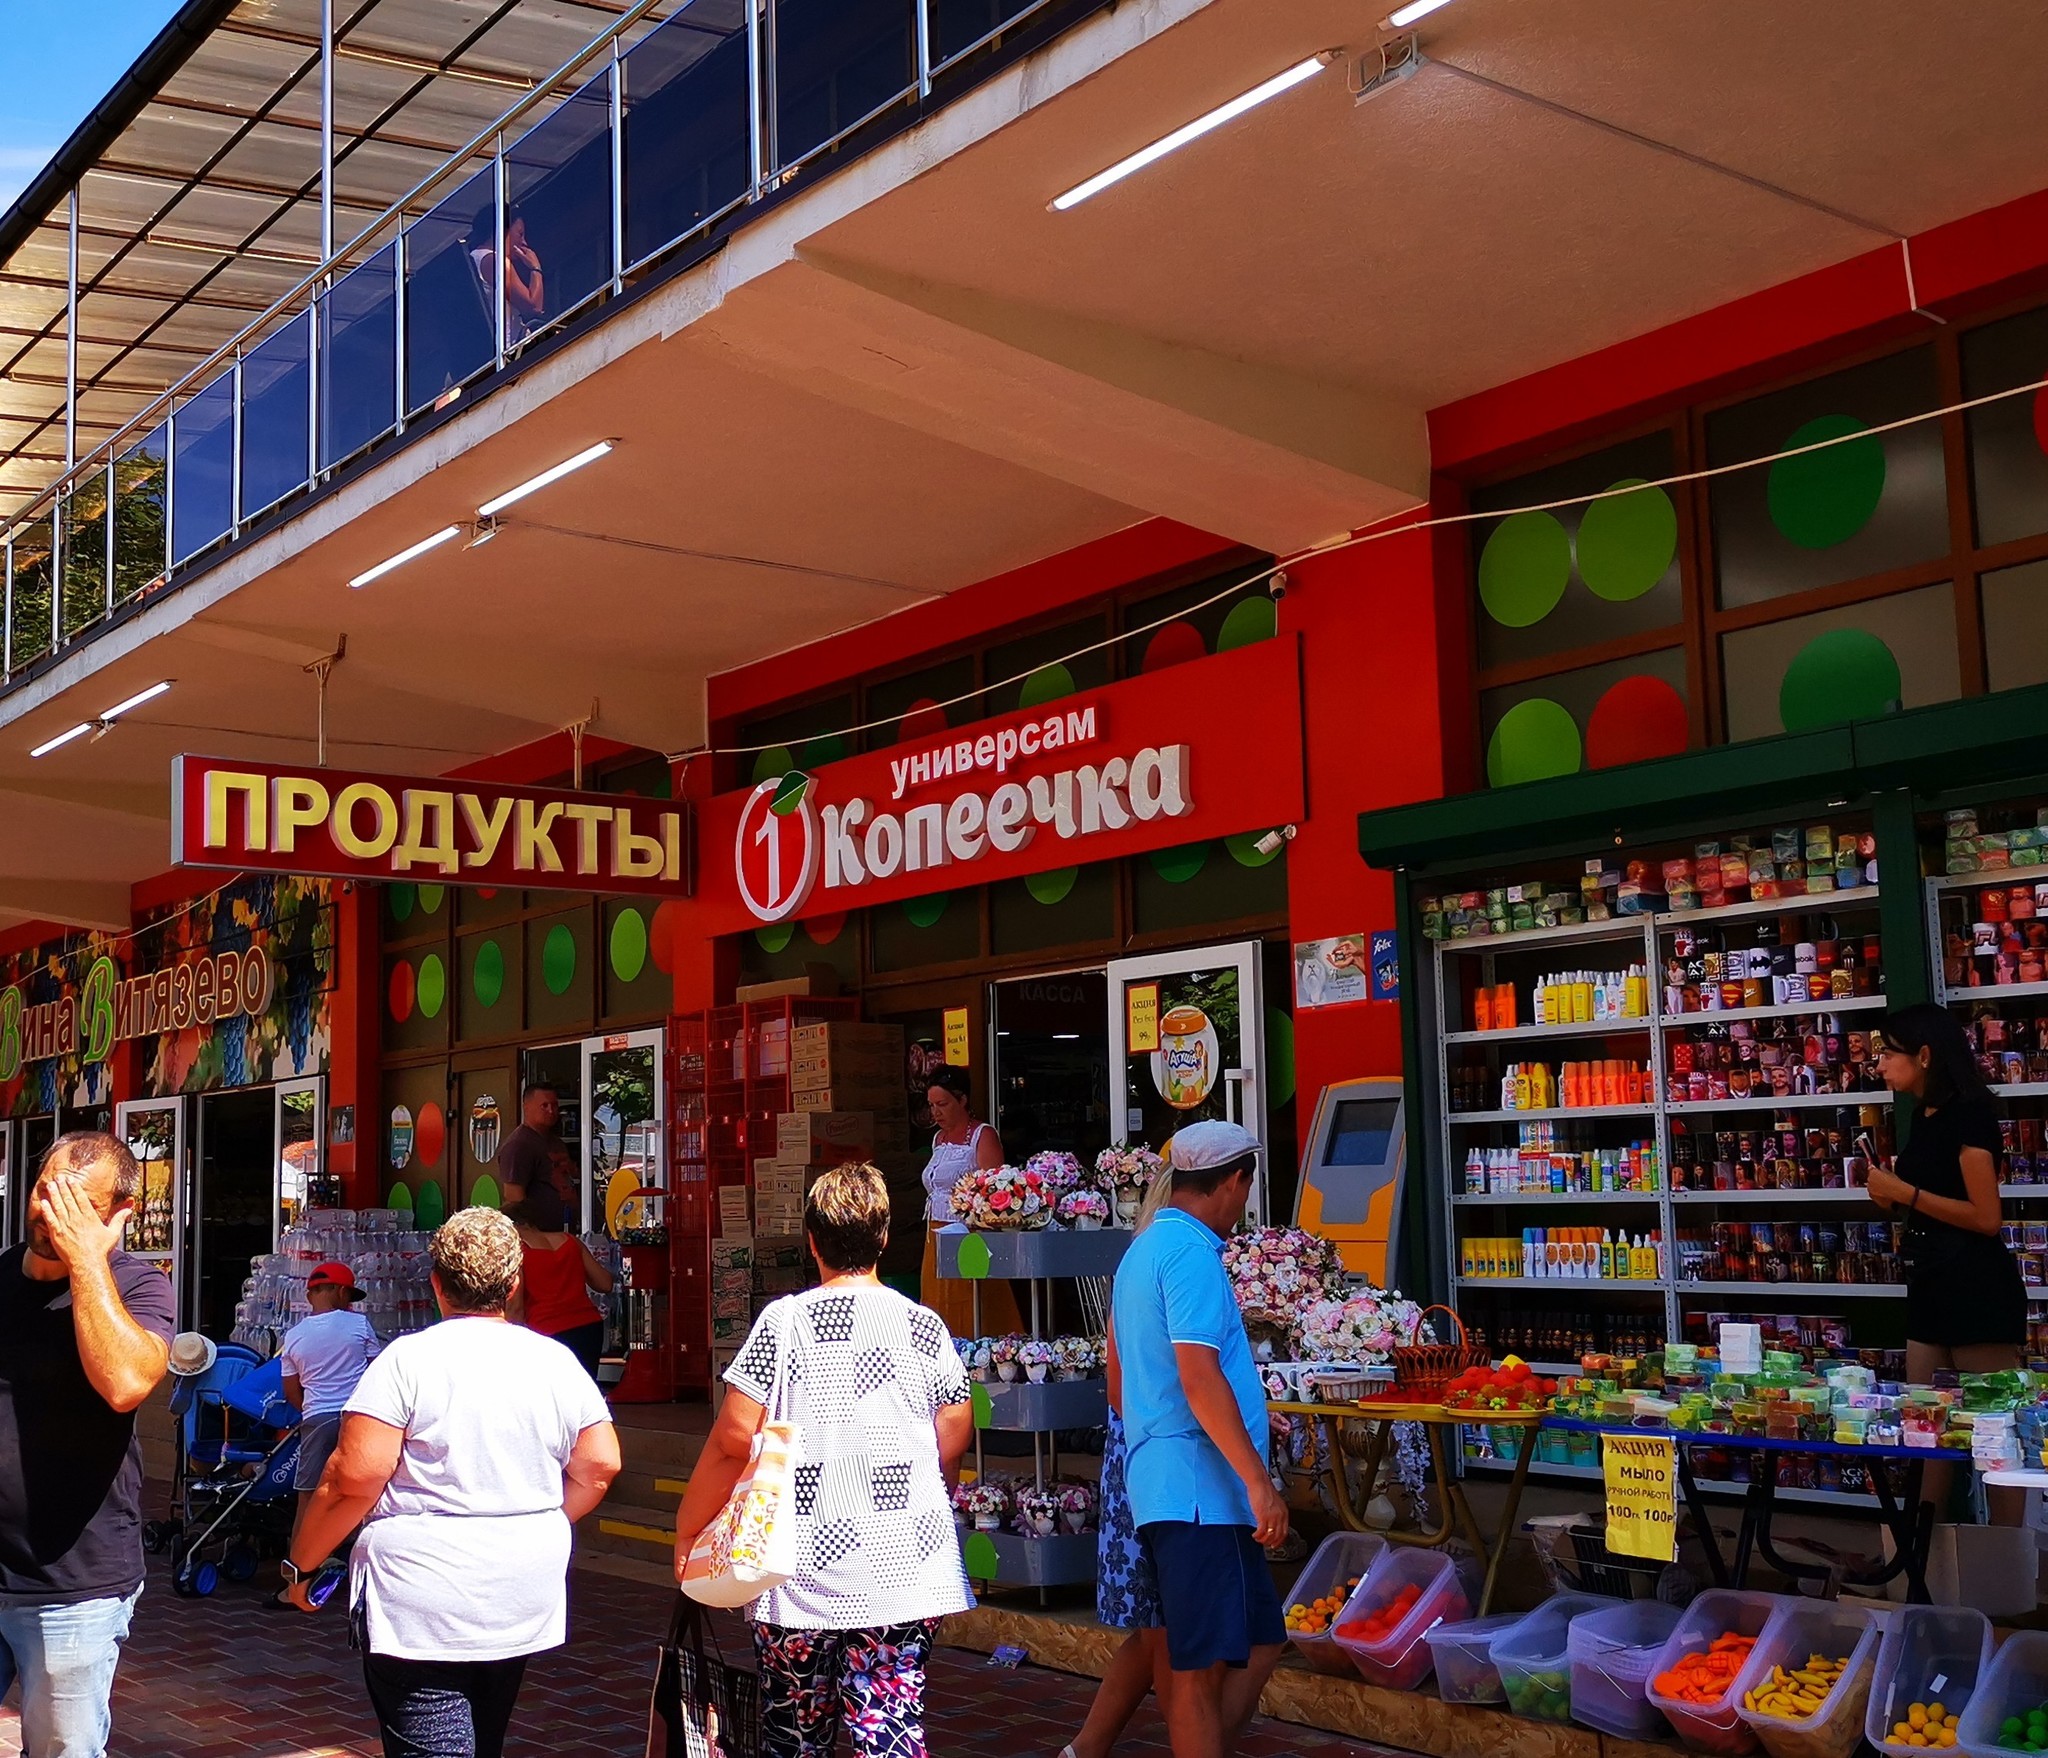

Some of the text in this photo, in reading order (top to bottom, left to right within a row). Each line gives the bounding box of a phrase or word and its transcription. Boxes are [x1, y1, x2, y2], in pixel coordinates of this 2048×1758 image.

[891, 707, 1096, 798] универсам
[203, 770, 680, 881] ПРОДУКТЫ
[822, 744, 1192, 888] Копеечка
[81, 945, 267, 1064] Витязево
[1019, 982, 1087, 1004] КАССА
[1609, 1440, 1666, 1458] АКЦИЯ
[1620, 1466, 1665, 1482] МЫЛО
[1607, 1486, 1640, 1497] РУЧНОЙ
